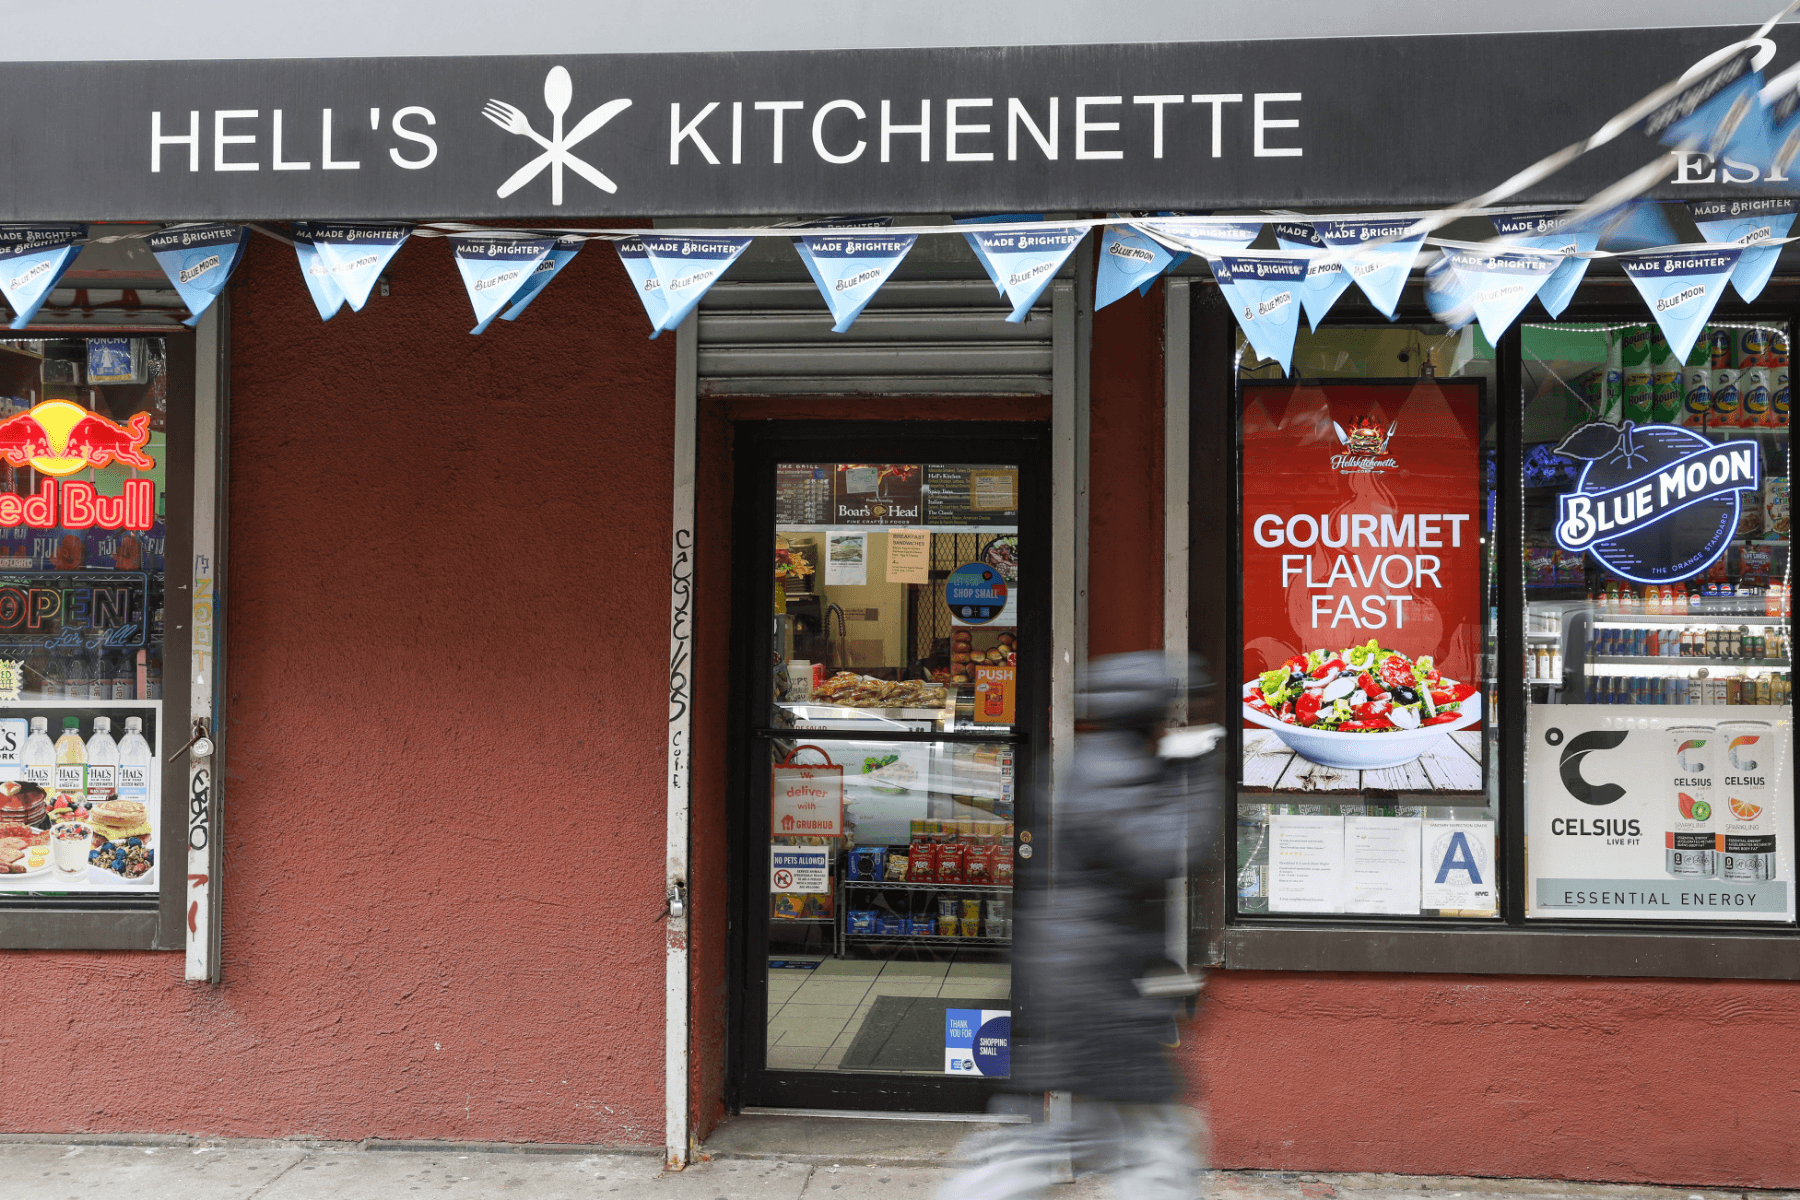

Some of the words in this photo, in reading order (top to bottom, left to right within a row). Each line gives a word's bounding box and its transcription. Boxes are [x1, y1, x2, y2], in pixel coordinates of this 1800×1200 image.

[150, 105, 438, 173] HELL'S
[669, 92, 1304, 165] KITCHENETTE
[1694, 204, 1727, 216] MADE
[1277, 224, 1308, 238] MADE
[1501, 221, 1533, 233] MADE
[315, 230, 344, 239] MADE
[1324, 228, 1356, 240] MADE
[152, 235, 179, 247] MADE
[650, 242, 679, 252] MADE
[812, 242, 842, 252] MADE
[984, 236, 1015, 248] MADE
[456, 244, 485, 254] MADE
[1109, 241, 1132, 259] BLUE
[1131, 248, 1154, 262] MOON
[354, 255, 378, 268] MOON
[1452, 255, 1482, 266] MADE
[1628, 261, 1660, 271] MADE
[179, 265, 201, 283] BLUE
[200, 256, 219, 270] MOON
[1009, 270, 1032, 286] BLUE
[1031, 262, 1055, 277] MOON
[1231, 264, 1255, 274] MADE
[1316, 263, 1342, 275] MOON
[474, 277, 496, 291] BLUE
[495, 270, 519, 284] MOON
[670, 277, 692, 291] BLUE
[691, 269, 714, 283] MOON
[835, 276, 859, 292] BLUE
[858, 268, 881, 283] MOON
[1257, 299, 1275, 315] BLUE
[1273, 292, 1291, 308] MOON
[1656, 293, 1680, 312] BLUE
[1680, 286, 1705, 302] MOON
[1560, 482, 1653, 547] BLUE
[1658, 448, 1752, 508] MOON
[0, 478, 58, 528] ed
[62, 479, 155, 531] Bull
[838, 504, 870, 518] Boar's
[888, 504, 919, 517] Head
[1252, 512, 1470, 549] GOURMET
[34, 537, 59, 558] FIJI
[98, 538, 118, 557] FIJI
[1651, 566, 1668, 575] THE
[1671, 552, 1705, 573] ORANGE
[1703, 512, 1729, 553] STANDARD
[1281, 553, 1443, 589] FLAVOR
[953, 588, 974, 599] SHOP
[975, 588, 999, 599] SMALL
[0, 588, 129, 629] OPEN
[1310, 594, 1413, 630] FAST
[45, 625, 83, 650] For
[86, 624, 138, 650] All
[977, 669, 1013, 681] PUSH
[27, 768, 49, 780] HAL'S
[59, 768, 80, 780] HAL'S
[90, 768, 112, 780] HAL'S
[122, 768, 143, 780] HAL'S
[800, 771, 815, 779] We
[1674, 777, 1712, 788] CELSIUS
[1725, 776, 1765, 787] CELSIUS
[786, 785, 828, 798] deliver
[797, 802, 816, 810] with
[796, 819, 834, 830] GRUBHUB
[1551, 817, 1641, 837] CELSIUS
[1674, 822, 1707, 831] SPARKLING
[1725, 823, 1760, 832] SPARKLING
[1606, 837, 1627, 845] LIVE
[1628, 837, 1641, 845] FIT
[774, 856, 783, 865] NO
[783, 856, 798, 865] PETS
[799, 856, 825, 866] ALLOWED
[1434, 831, 1484, 885] A
[1564, 891, 1671, 905] ESSENTIAL
[1681, 892, 1757, 906] ENERGY
[949, 1019, 968, 1029] THANK
[949, 1028, 961, 1038] YOU
[961, 1028, 973, 1038] FOR
[979, 1037, 1008, 1047] SHOPPING
[979, 1046, 998, 1056] SMALL
